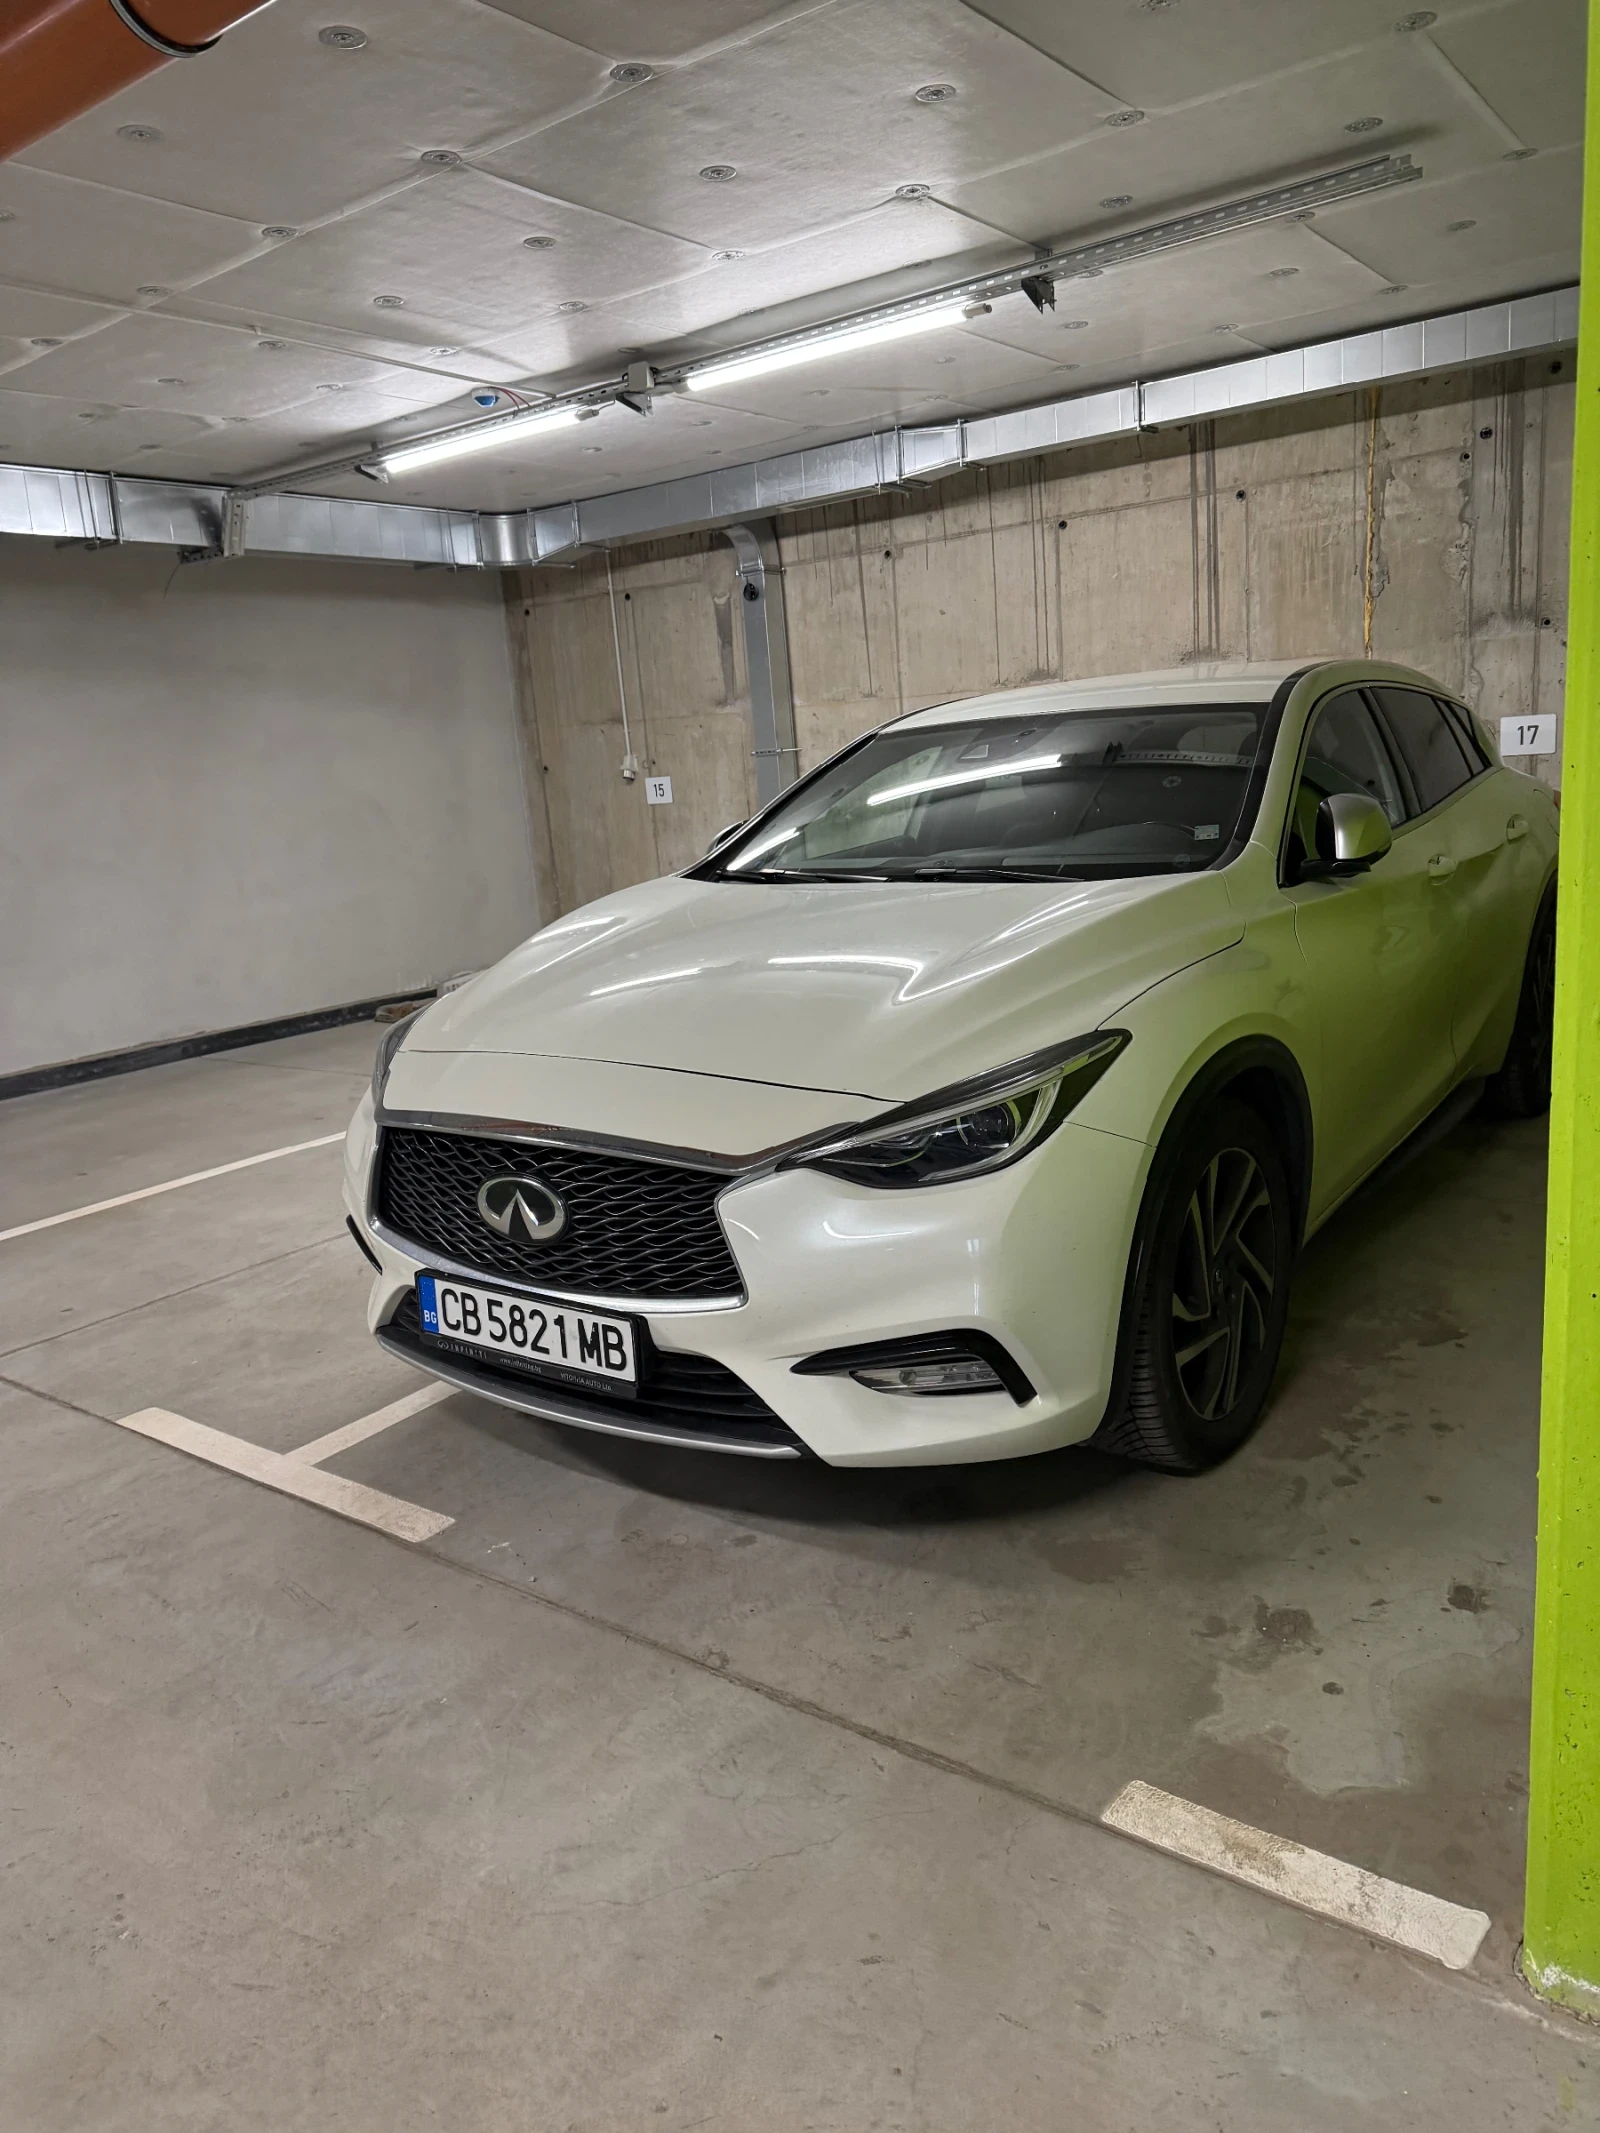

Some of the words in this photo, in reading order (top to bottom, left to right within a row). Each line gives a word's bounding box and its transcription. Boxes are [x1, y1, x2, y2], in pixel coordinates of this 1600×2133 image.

[1517, 725, 1539, 745] 17
[653, 783, 665, 798] 15
[423, 1309, 437, 1325] BG
